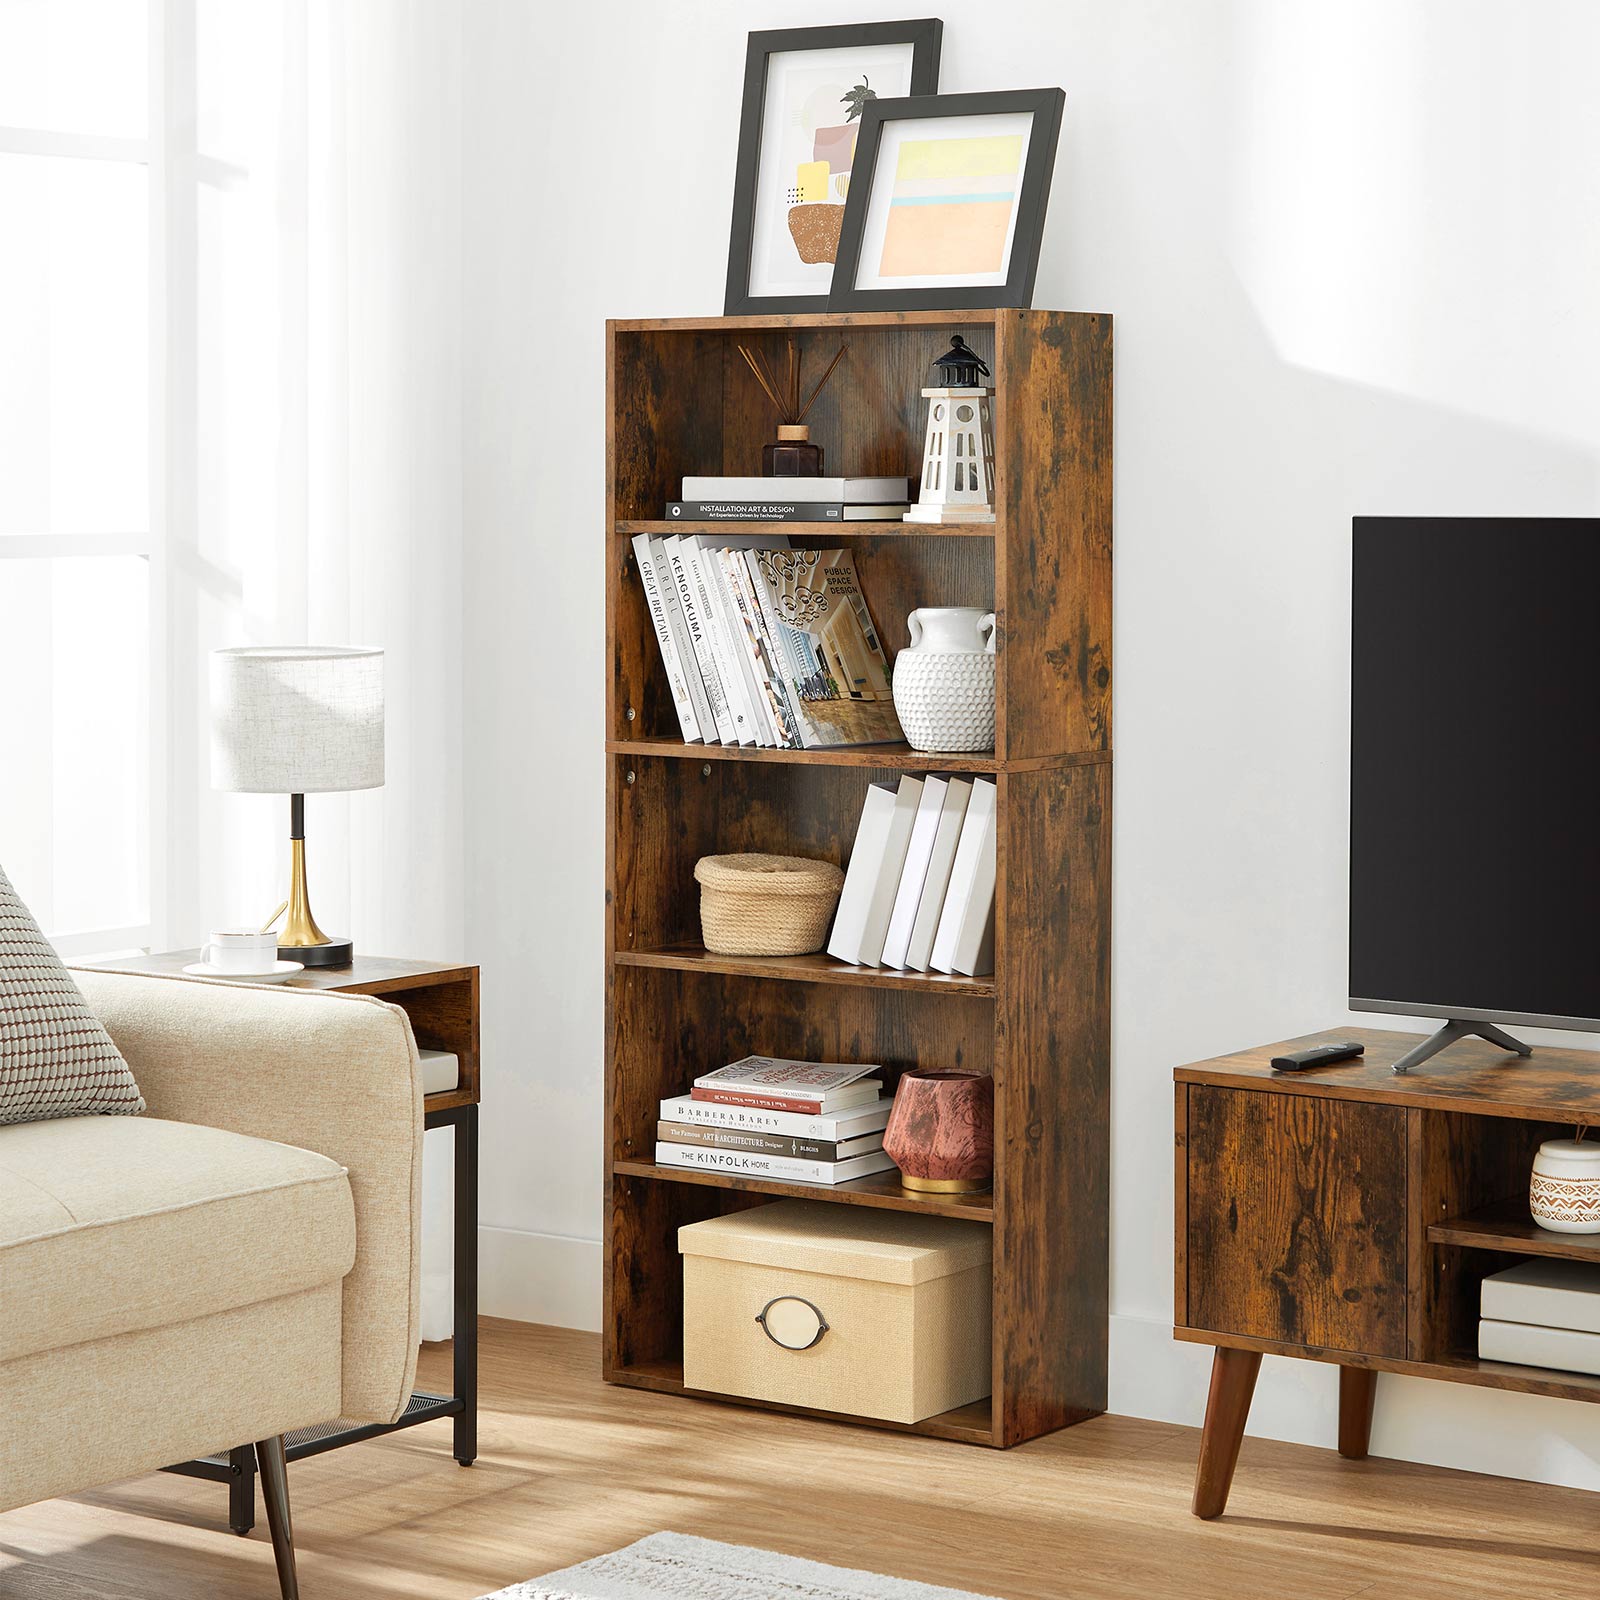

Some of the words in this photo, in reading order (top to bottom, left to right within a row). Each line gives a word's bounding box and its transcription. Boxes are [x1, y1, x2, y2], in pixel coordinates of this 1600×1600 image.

[641, 560, 657, 597] GREAT
[651, 598, 669, 643] BRITAIN
[654, 553, 677, 614] CEREAL
[754, 578, 770, 614] PUBLIC
[764, 615, 780, 650] SPACE
[775, 650, 791, 686] DESIGN
[678, 1107, 734, 1120] BARBERA
[739, 1114, 779, 1126] BAREY
[681, 1152, 694, 1160] THE
[697, 1153, 749, 1168] KINFOLK
[751, 1160, 770, 1169] HOME
